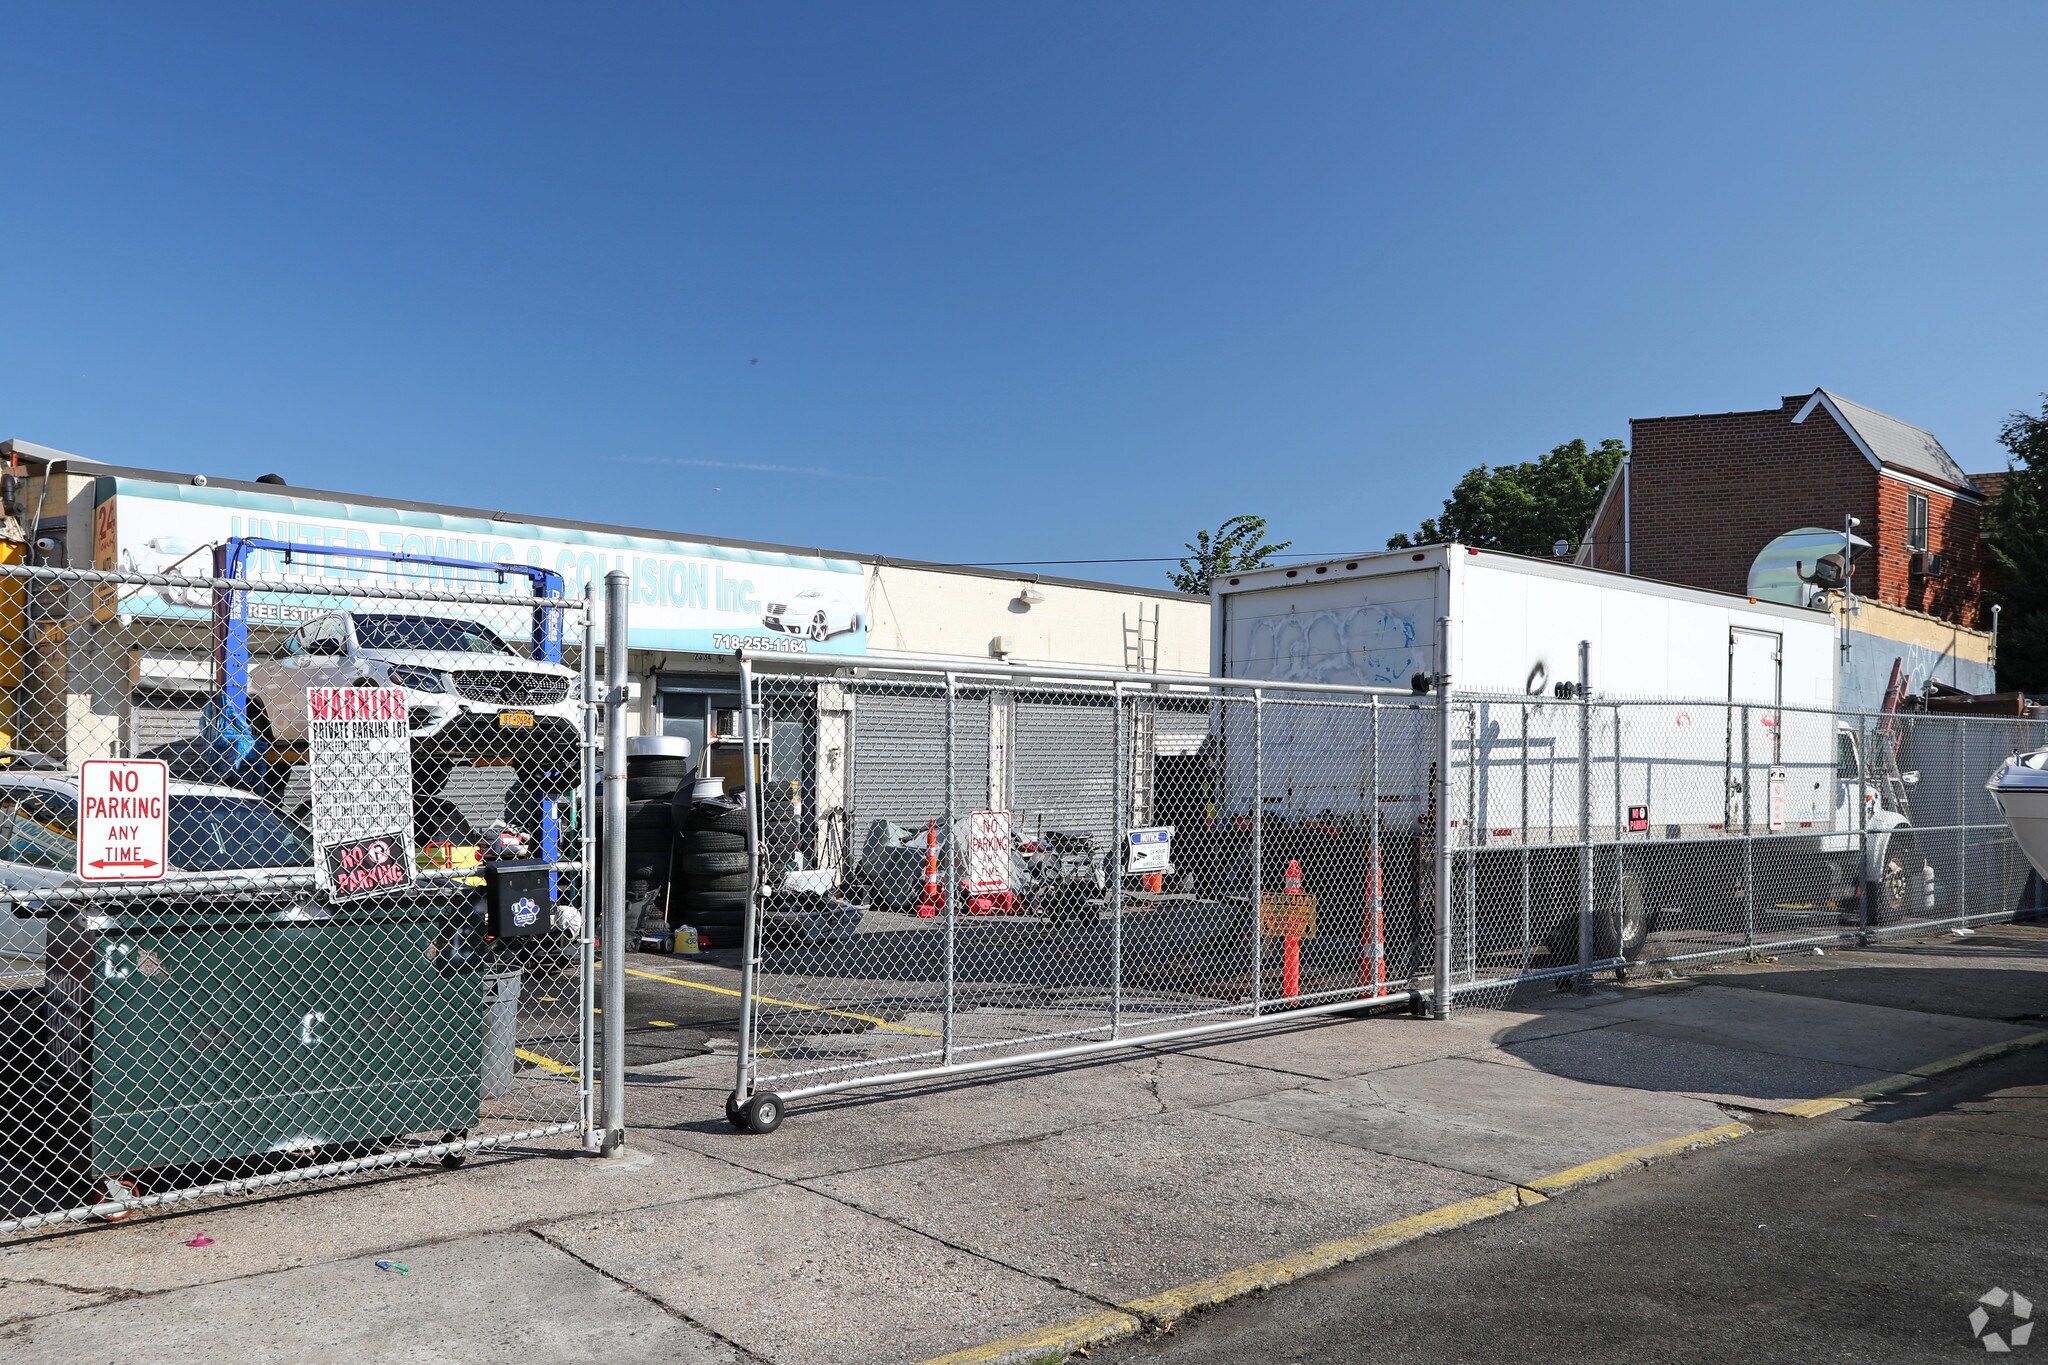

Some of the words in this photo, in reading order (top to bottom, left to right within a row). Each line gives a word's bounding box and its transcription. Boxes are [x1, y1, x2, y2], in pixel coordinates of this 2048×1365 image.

[231, 516, 371, 581] UNITED
[379, 531, 514, 593] TOWING
[525, 545, 543, 592] &
[716, 566, 762, 614] Inc.
[247, 603, 278, 620] REE
[712, 633, 808, 653] 718-255-1164
[310, 689, 406, 721] WARNING
[313, 721, 349, 739] PRIVATE
[352, 721, 389, 739] PARKING
[109, 770, 139, 792] NO
[86, 797, 161, 819] PARKING
[108, 826, 139, 840] ANY
[983, 819, 998, 833] NO
[1629, 819, 1648, 830] PARKING
[972, 836, 1008, 851] PARKING
[1140, 832, 1159, 843] NOTICE
[105, 847, 142, 861] TIME
[341, 846, 364, 869] NO
[982, 854, 1000, 864] ANY
[337, 864, 404, 894] PARKING
[980, 866, 1000, 878] TIME
